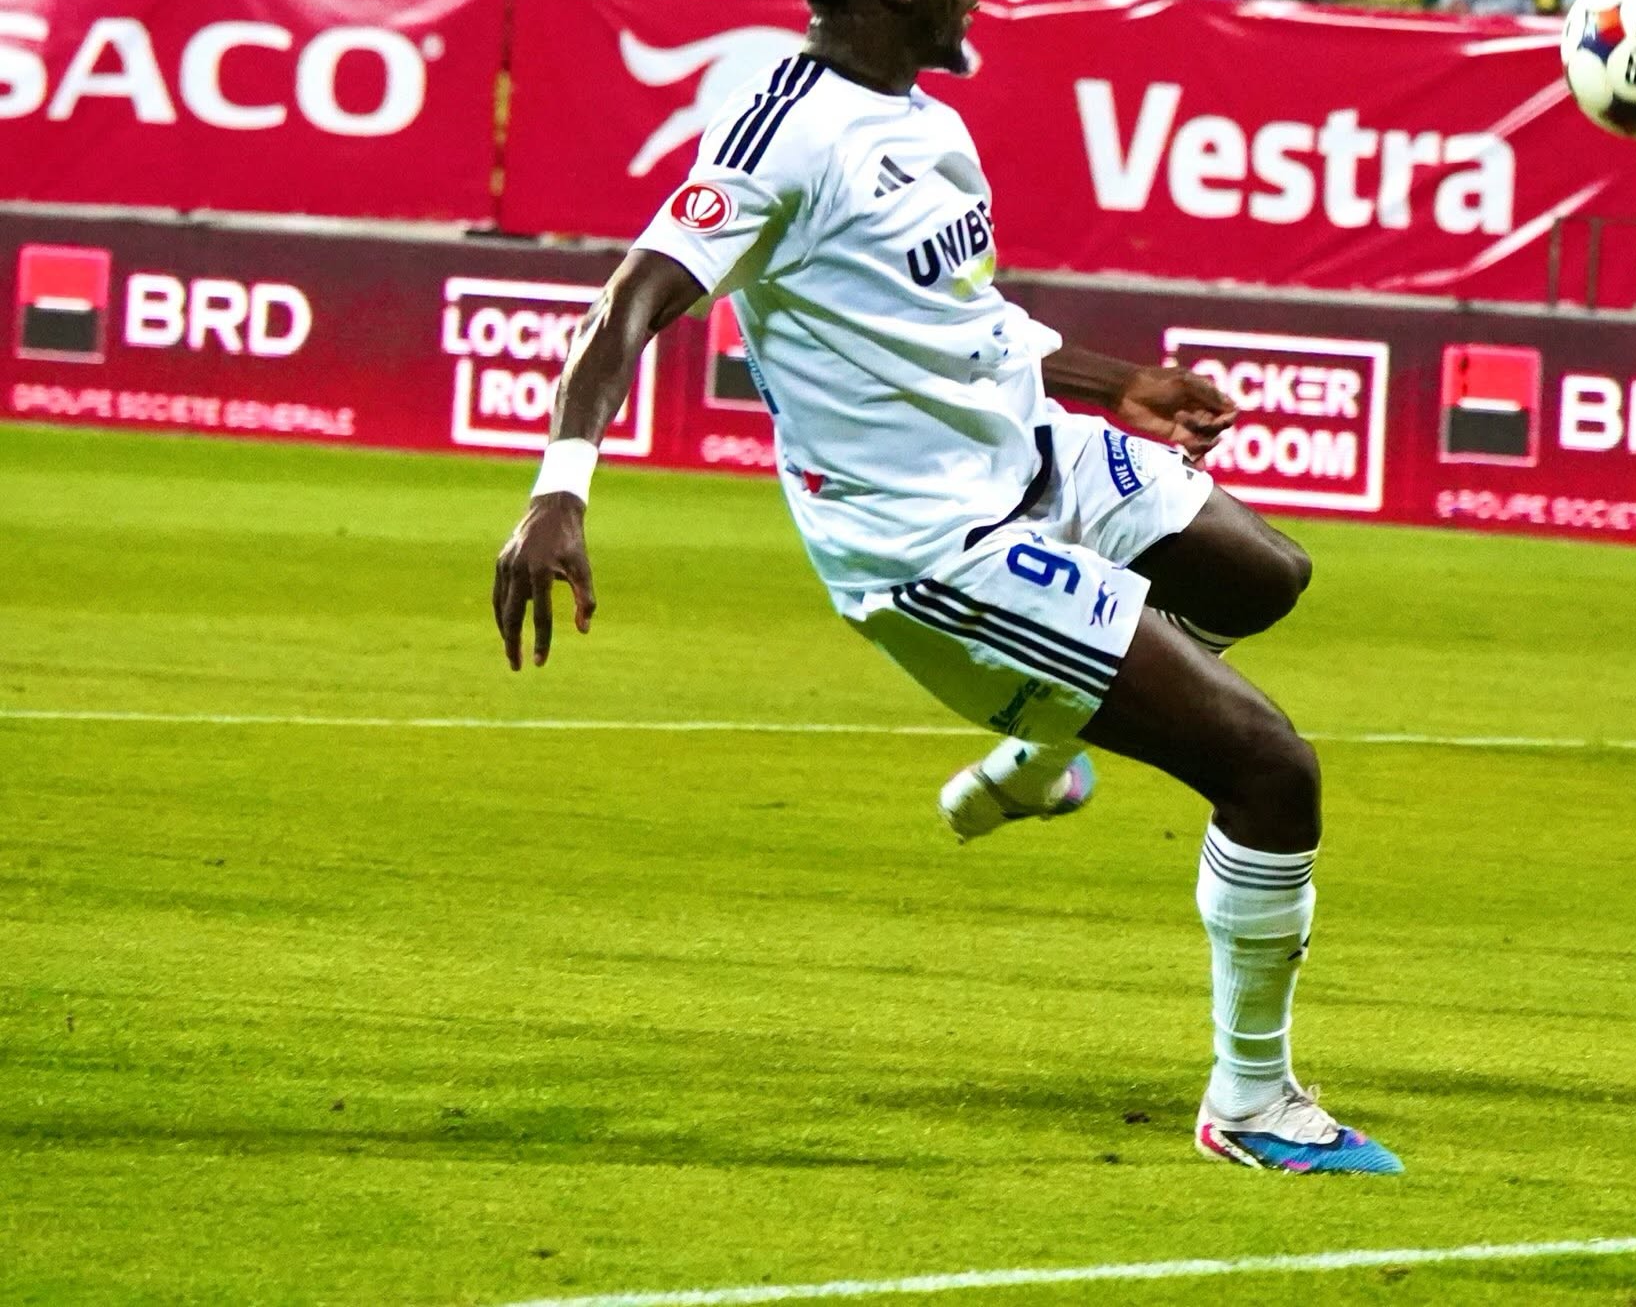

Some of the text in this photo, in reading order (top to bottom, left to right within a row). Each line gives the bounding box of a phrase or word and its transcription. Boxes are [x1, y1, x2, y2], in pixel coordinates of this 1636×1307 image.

[1074, 78, 1517, 235] Vestra
[125, 273, 312, 357] BRD
[478, 369, 562, 422] RO
[1114, 463, 1136, 491] FIVE
[1006, 542, 1081, 596] 9
